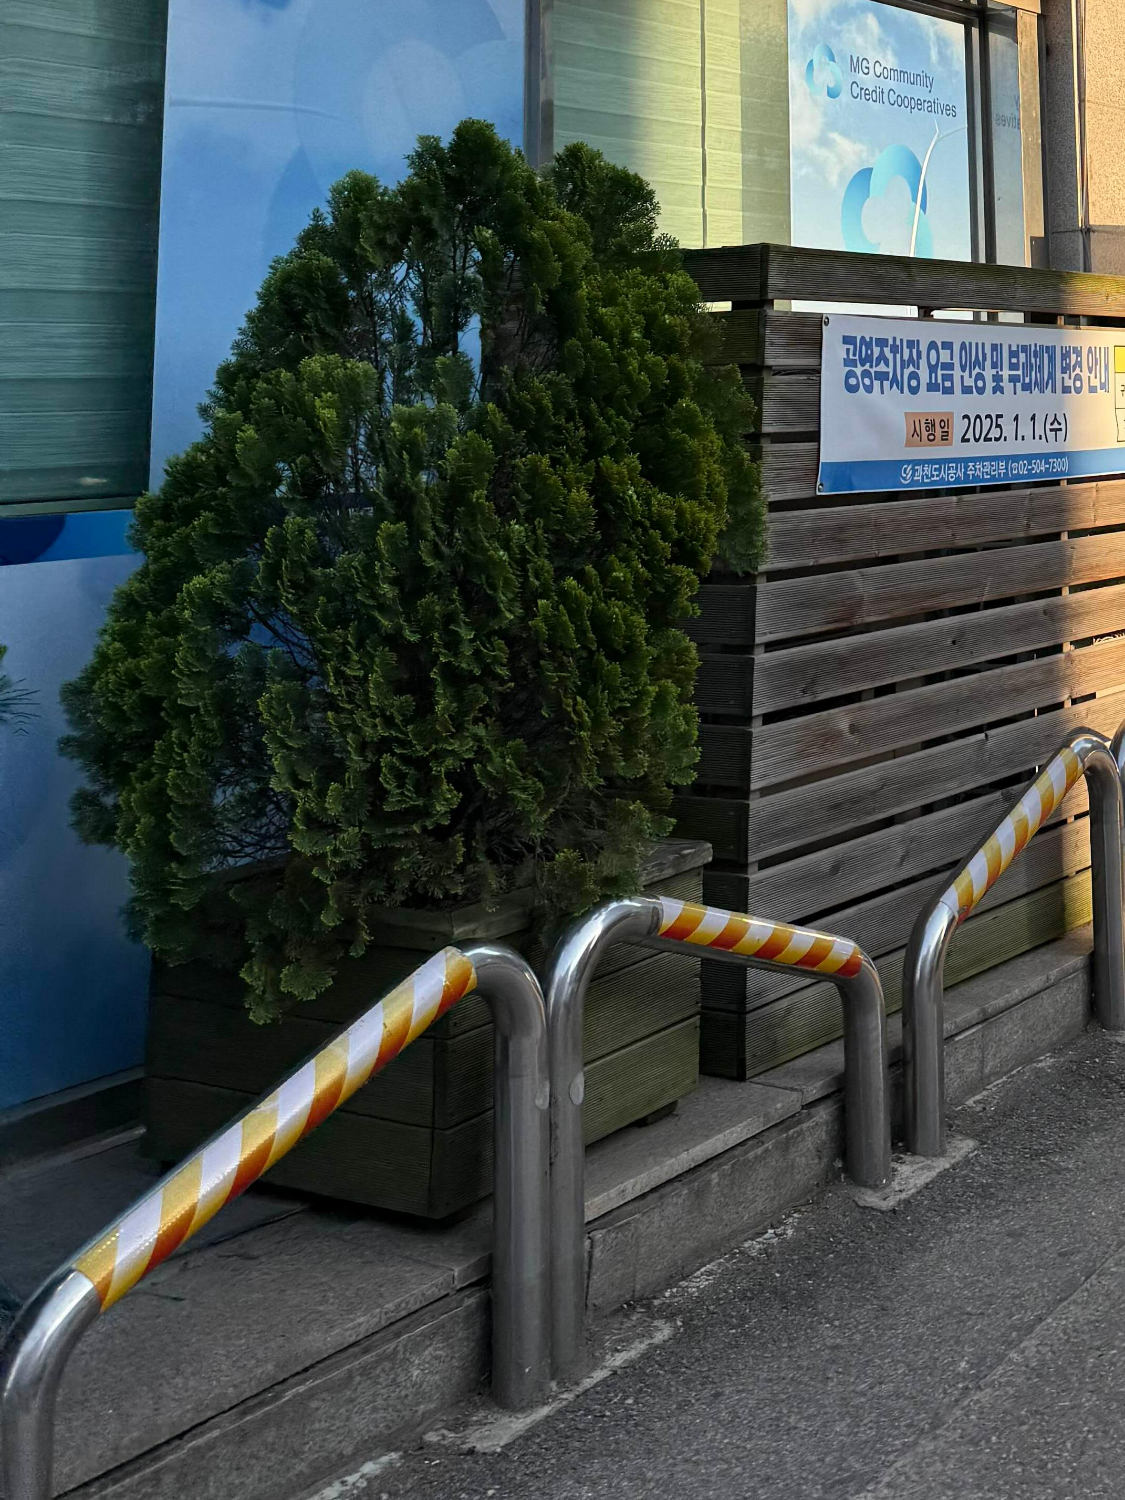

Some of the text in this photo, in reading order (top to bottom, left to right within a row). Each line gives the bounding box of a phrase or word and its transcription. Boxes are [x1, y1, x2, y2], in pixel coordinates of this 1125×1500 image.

[849, 54, 934, 93] MG Community
[850, 81, 957, 118] Credit Cooperatives
[841, 333, 1110, 396] 공영주차장 요금 인상 및 부과체계 변경 안내
[910, 416, 951, 443] 시행일
[913, 461, 965, 484] 과천도시공사
[966, 459, 1007, 481] 주차관리부
